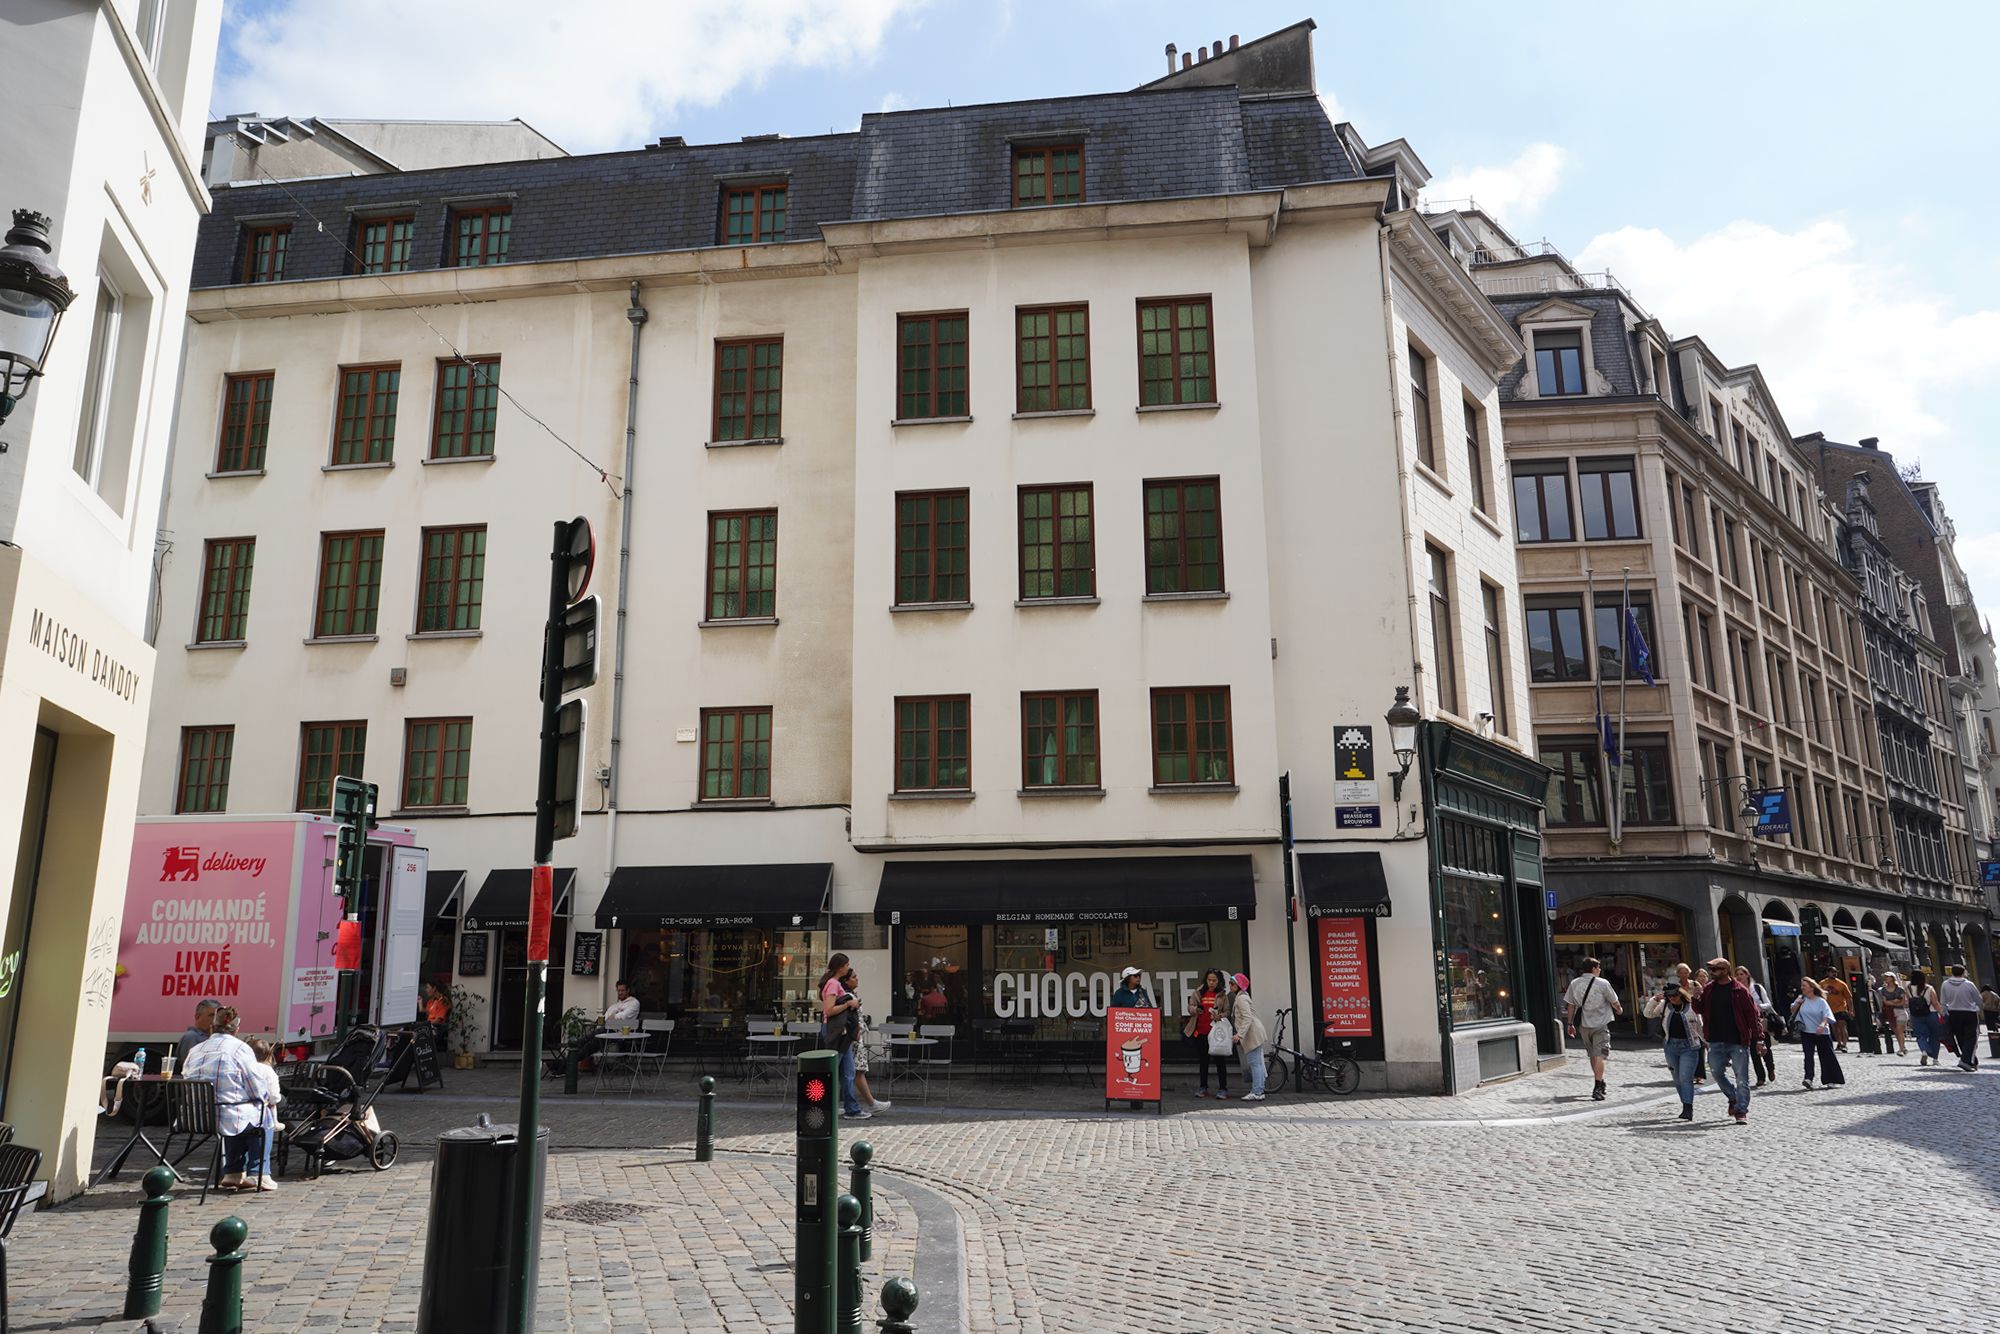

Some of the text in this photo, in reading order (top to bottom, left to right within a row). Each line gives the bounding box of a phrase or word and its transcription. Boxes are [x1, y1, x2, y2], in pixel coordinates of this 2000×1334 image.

[30, 608, 139, 704] MAISON DANDOY
[1757, 823, 1788, 831] FEDERALE
[202, 851, 267, 877] delivery
[406, 863, 417, 872] 256
[151, 891, 266, 921] COMMANDÉ
[1078, 912, 1129, 920] CHOCOLATES
[660, 917, 702, 925] ICE-CREAM
[715, 917, 753, 925] TEA-ROOM
[1564, 912, 1661, 932] Lace Palace
[135, 922, 276, 948] AUJOURD'HUI,
[174, 944, 231, 973] LIVRÉ
[161, 974, 240, 996] DEMAIN
